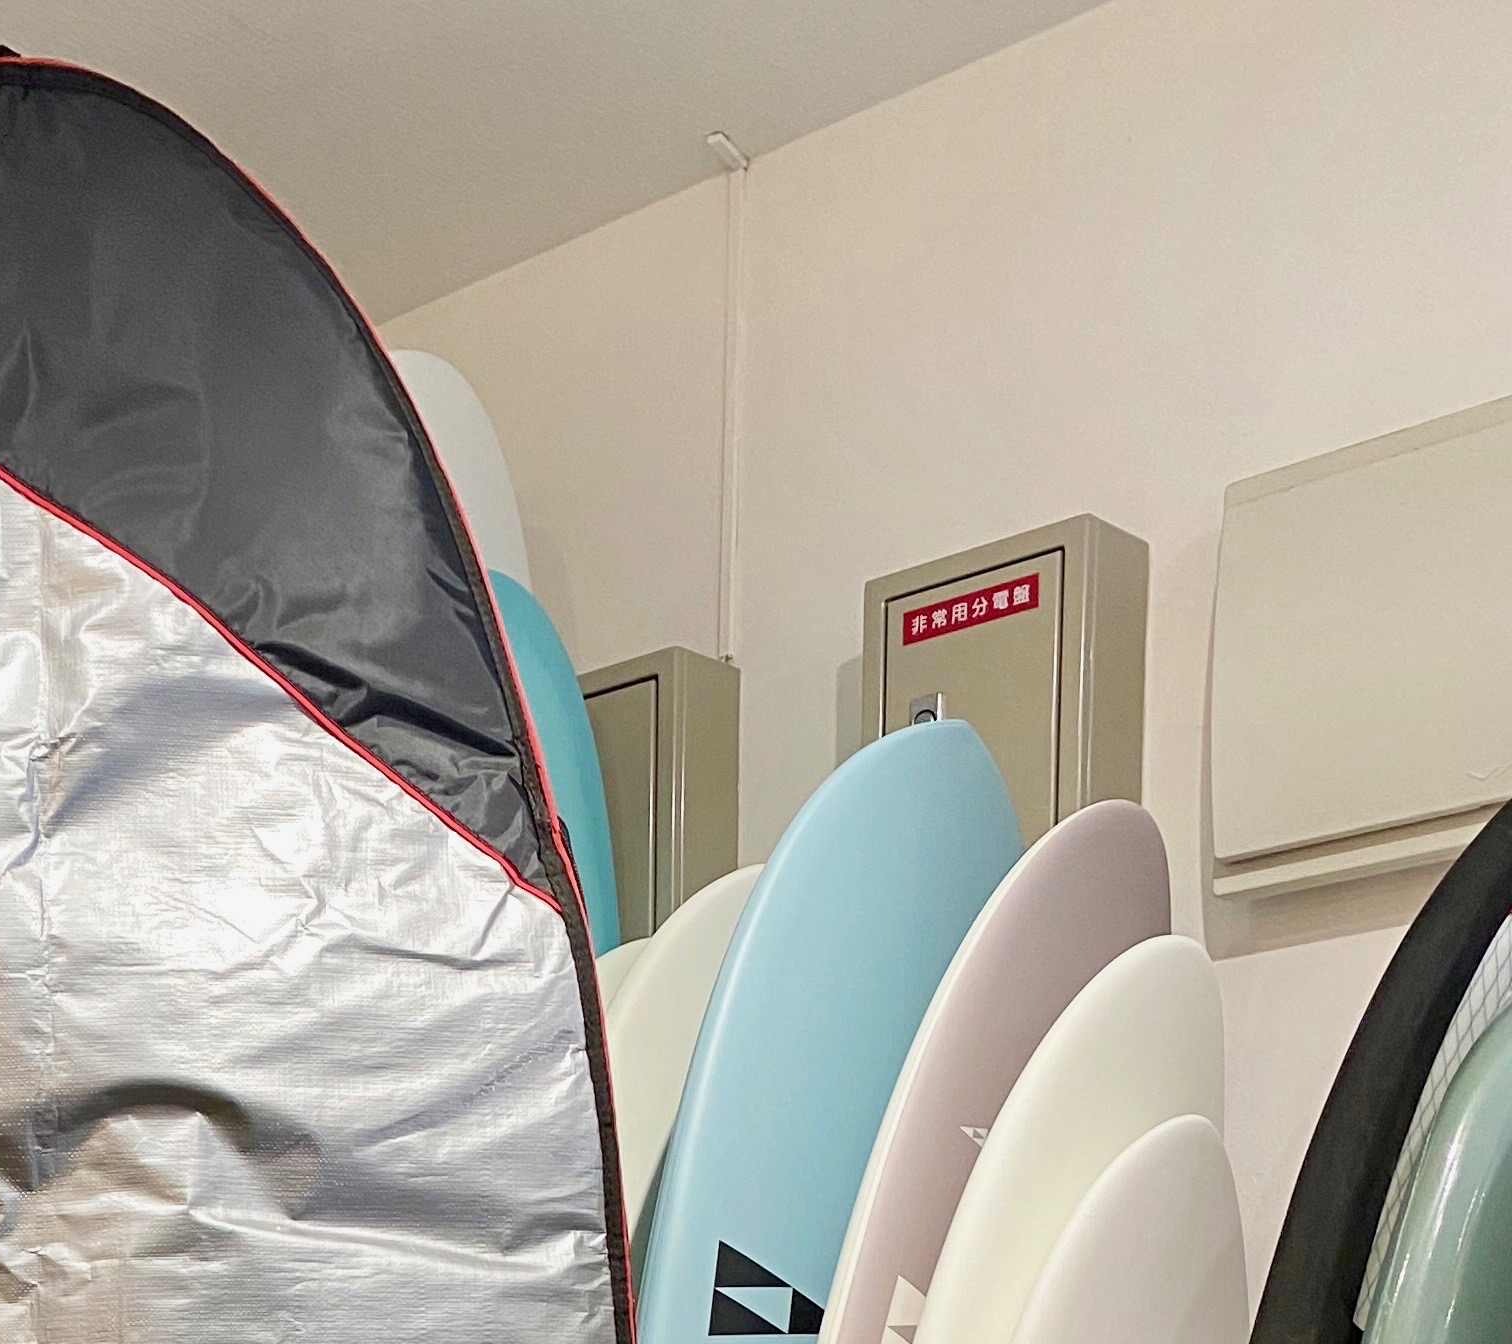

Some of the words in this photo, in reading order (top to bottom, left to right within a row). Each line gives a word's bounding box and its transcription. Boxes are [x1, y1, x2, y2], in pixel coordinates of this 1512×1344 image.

[911, 583, 1031, 636] 非常用分電盤
